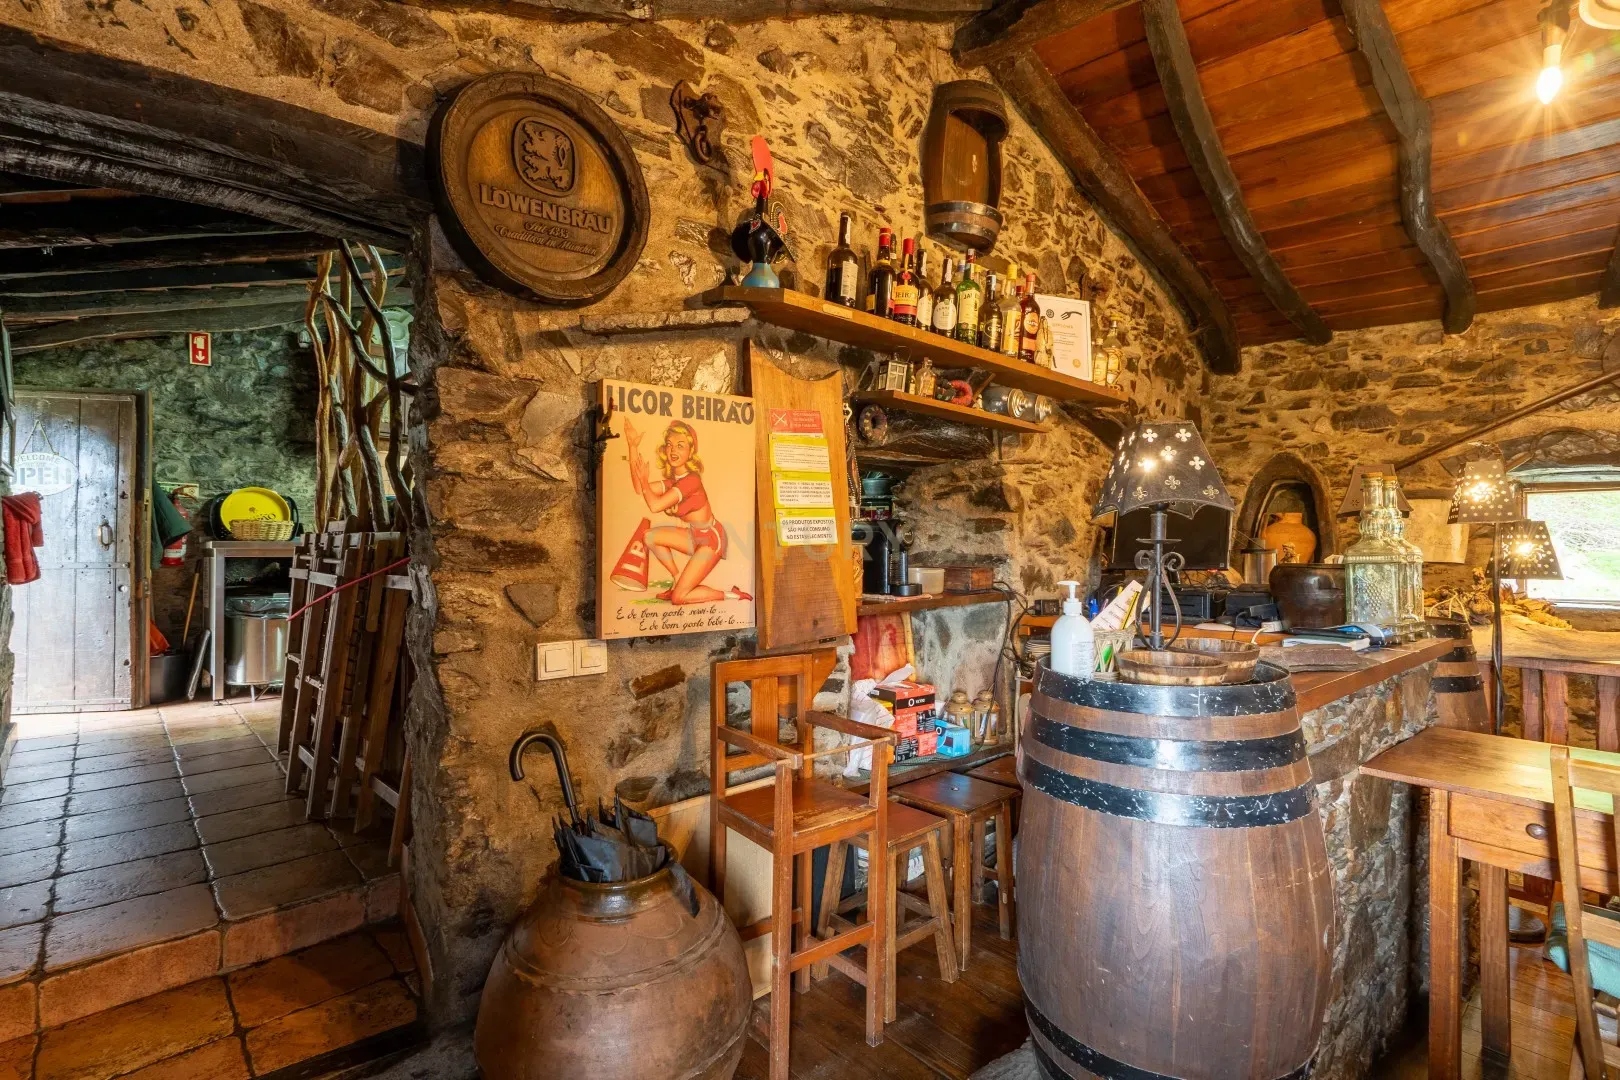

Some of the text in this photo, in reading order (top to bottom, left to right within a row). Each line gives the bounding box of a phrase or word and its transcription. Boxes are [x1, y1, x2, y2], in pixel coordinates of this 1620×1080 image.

[479, 183, 612, 234] LÖWENBRÄU
[494, 224, 545, 247] Tradition
[606, 385, 673, 417] LICOR
[682, 394, 755, 425] BEIRÃO
[627, 609, 637, 619] de
[641, 608, 658, 618] bom
[662, 606, 684, 620] gosto
[649, 620, 658, 630] de
[662, 619, 679, 629] bom
[682, 618, 704, 631] gosto
